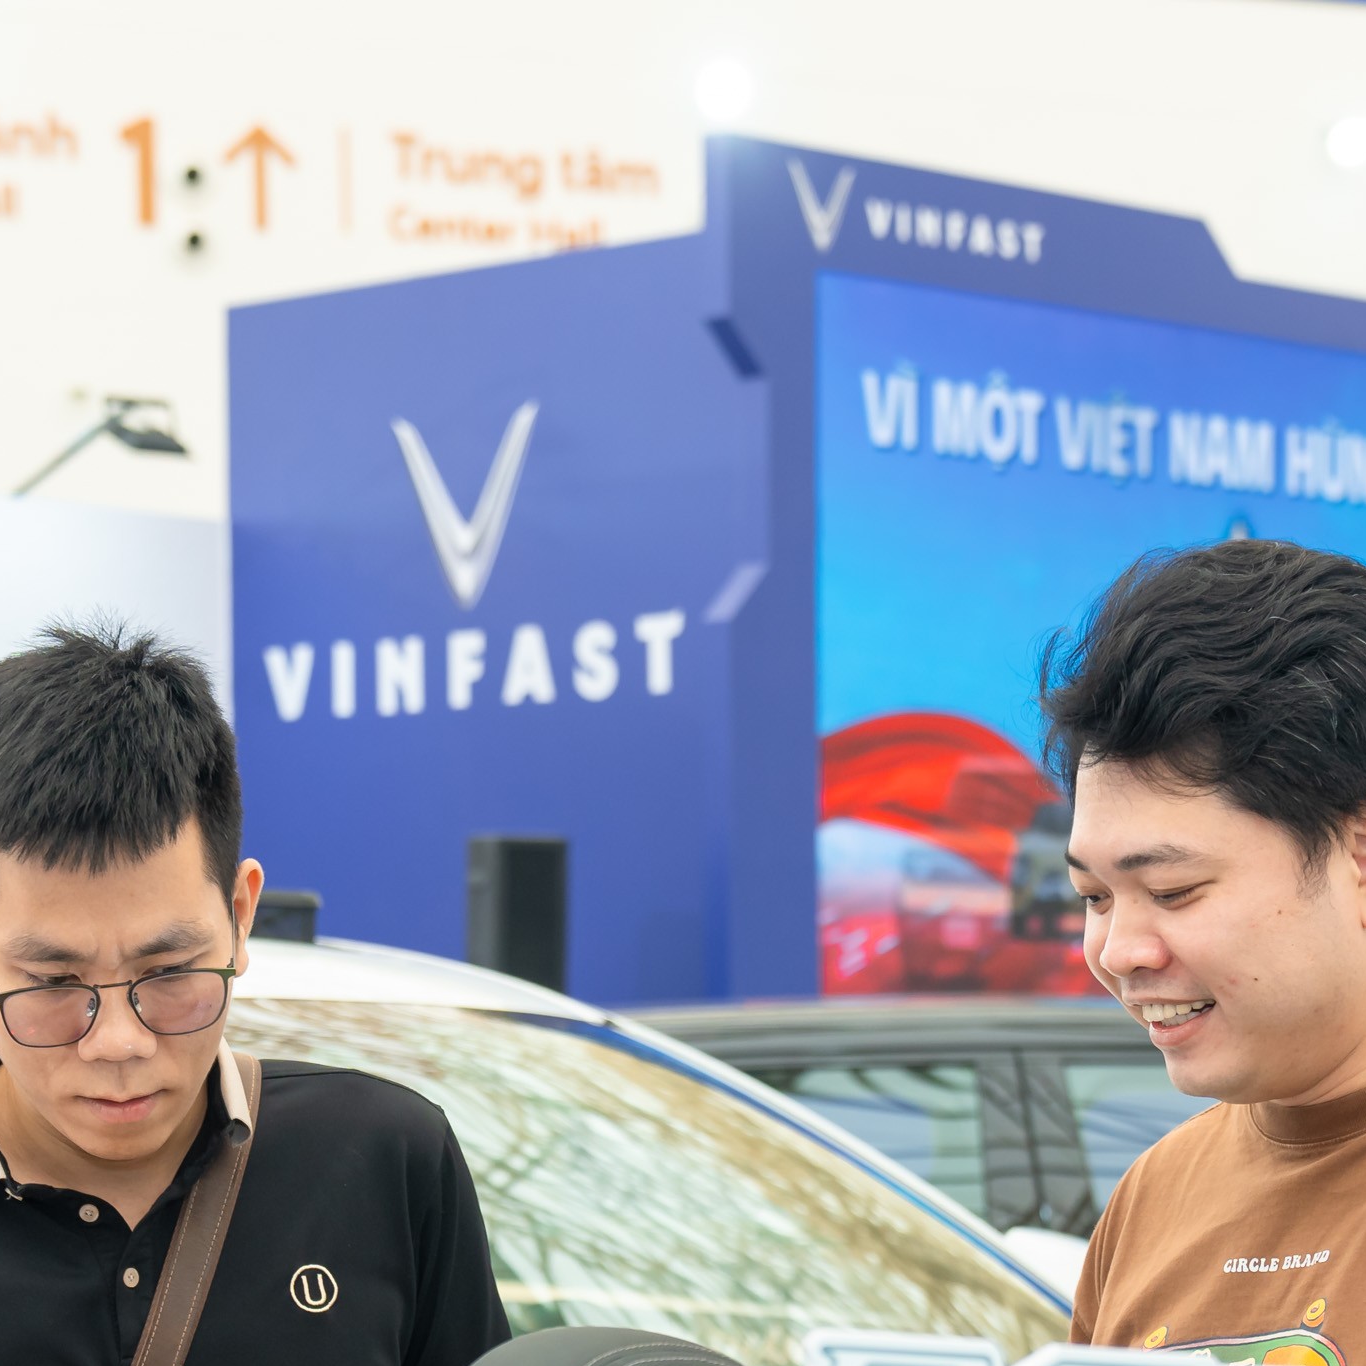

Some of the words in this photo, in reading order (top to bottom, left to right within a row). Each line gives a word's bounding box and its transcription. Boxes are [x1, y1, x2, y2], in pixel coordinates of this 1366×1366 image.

[120, 115, 158, 228] 1
[864, 195, 1045, 265] VINFAST
[1168, 409, 1276, 493] NAM
[262, 605, 687, 723] VINFAST
[1223, 1257, 1280, 1273] CIRCLE
